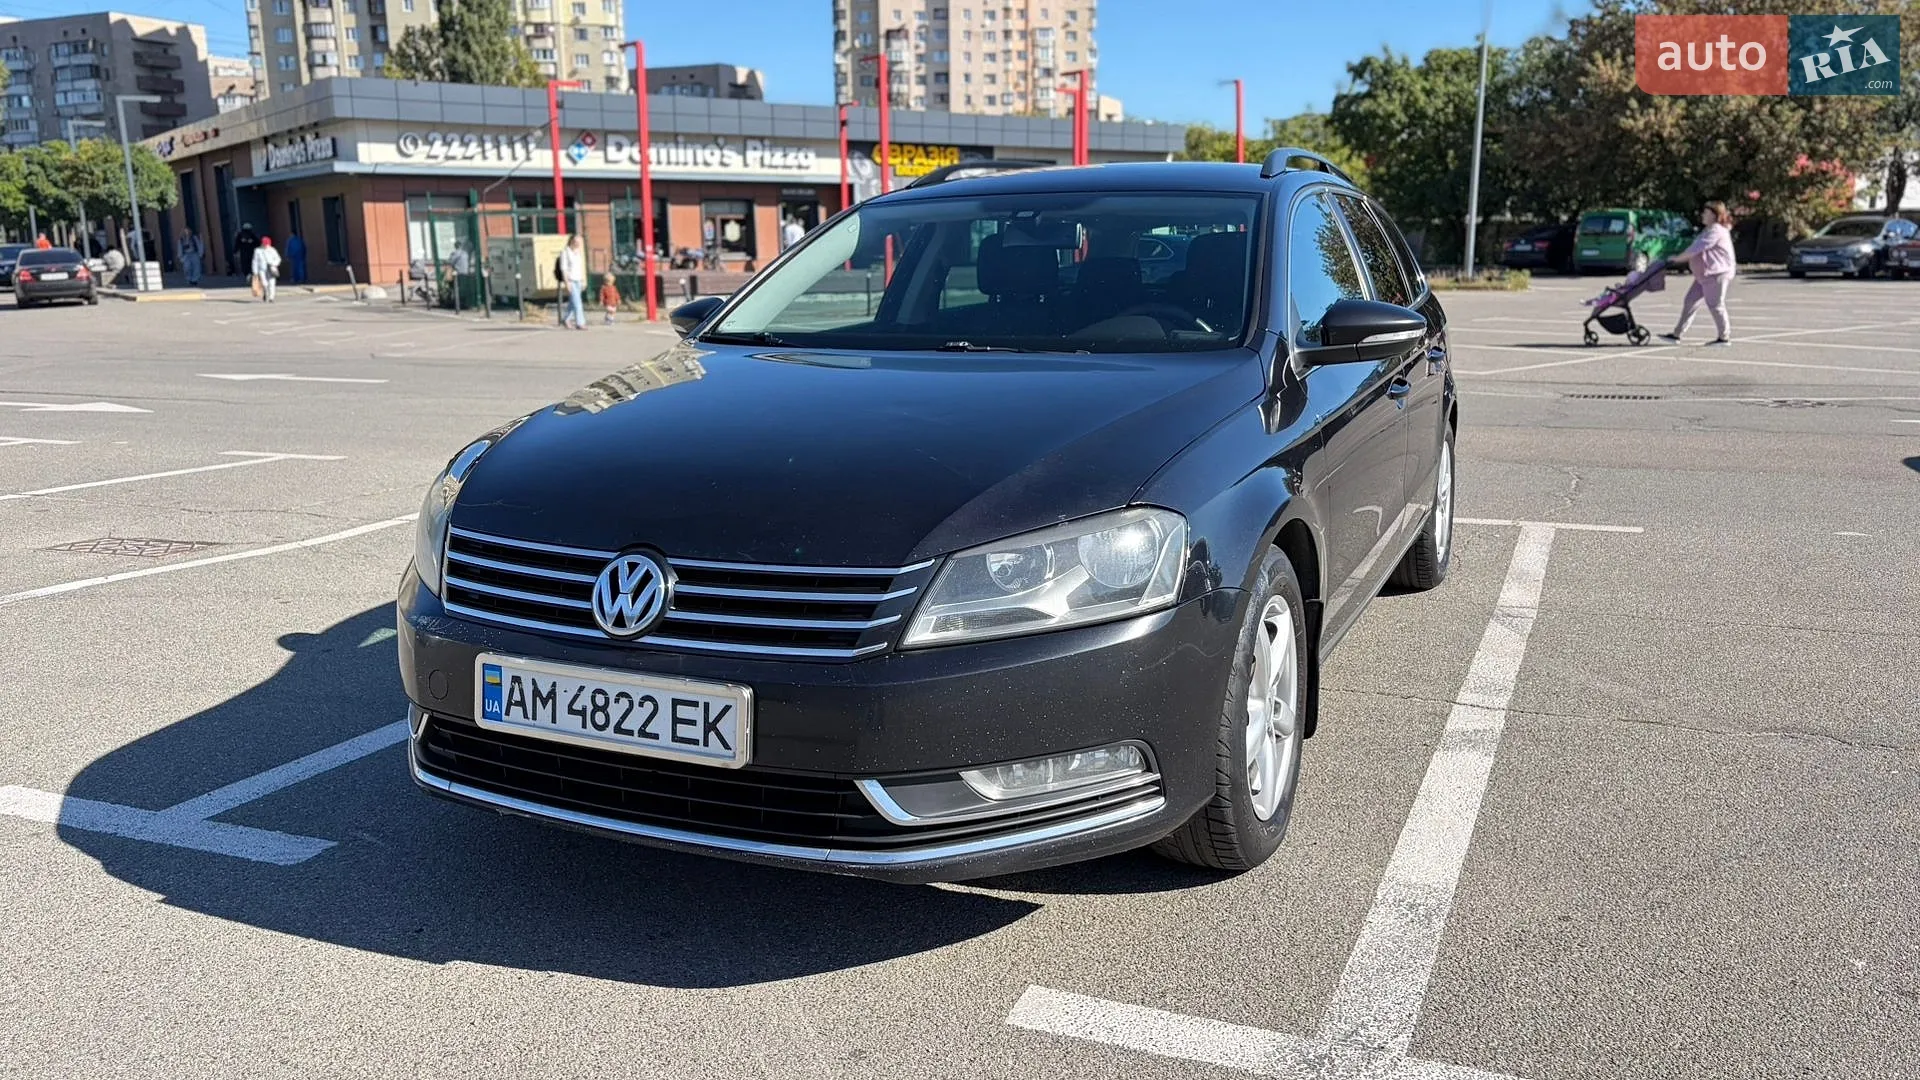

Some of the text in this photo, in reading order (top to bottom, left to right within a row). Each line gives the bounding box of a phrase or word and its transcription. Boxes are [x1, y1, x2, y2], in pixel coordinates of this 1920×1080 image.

[605, 133, 816, 169] Domino's Pizza
[485, 698, 501, 714] UA
[504, 675, 733, 751] AM 4822 EK
